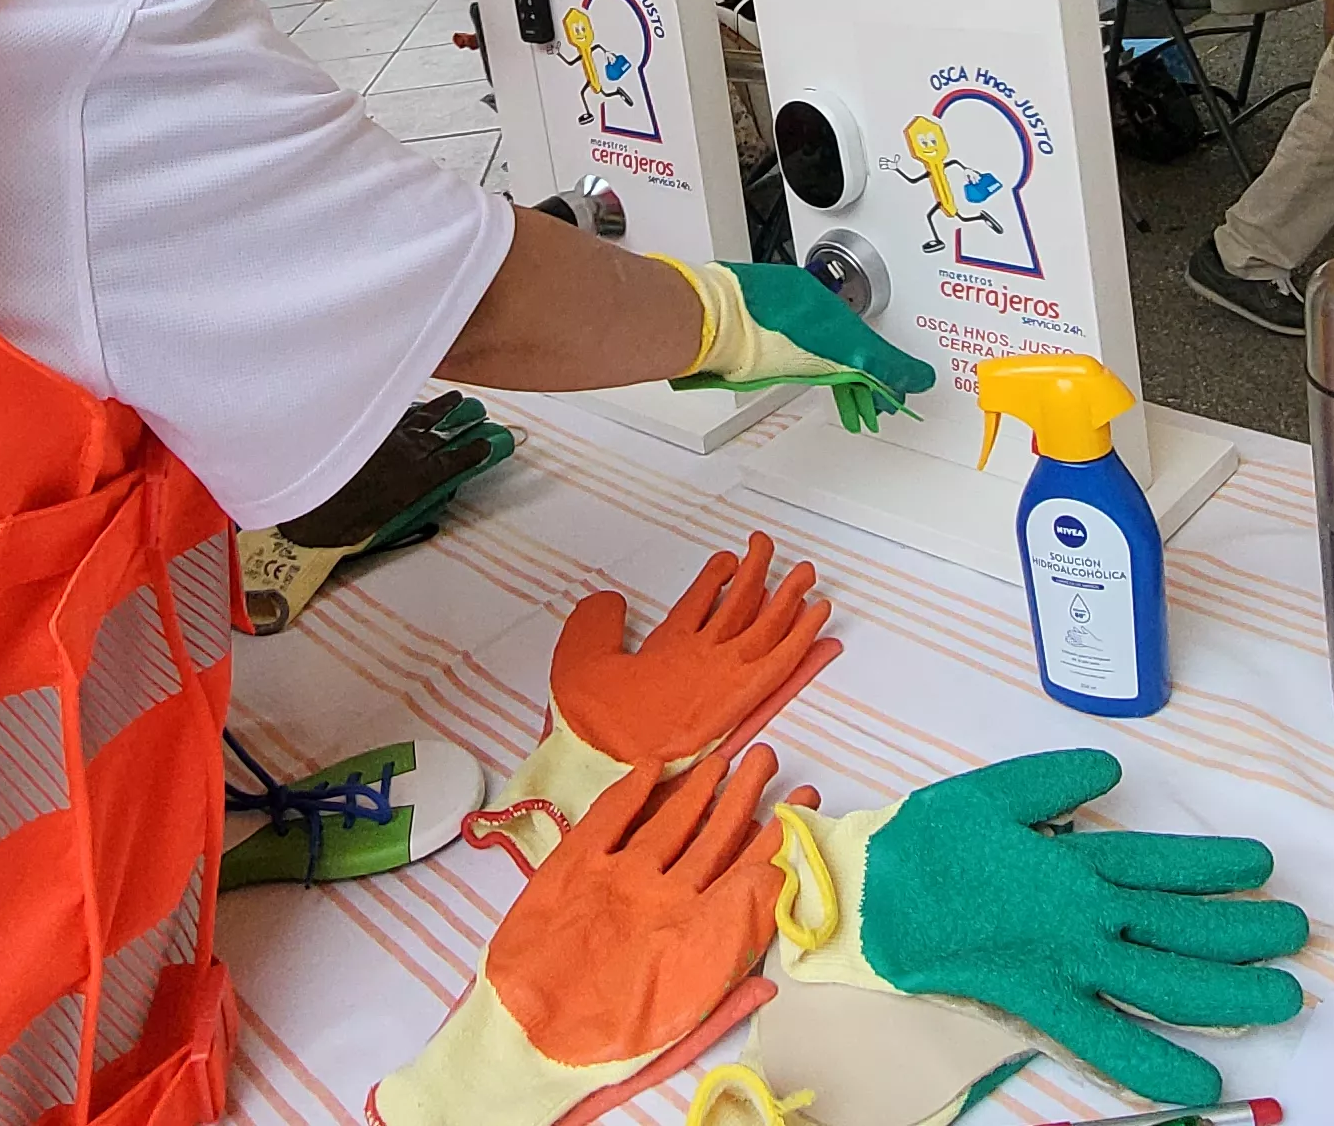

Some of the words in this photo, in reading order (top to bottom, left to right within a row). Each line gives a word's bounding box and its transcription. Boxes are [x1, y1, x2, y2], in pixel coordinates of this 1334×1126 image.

[930, 65, 969, 91] OSCA
[975, 67, 1015, 99] Hnos
[1014, 99, 1054, 155] JUSTO
[590, 138, 628, 152] maestros
[592, 148, 674, 177] cerrajeros
[648, 175, 675, 188] servicio
[939, 269, 993, 287] maestros
[941, 281, 1060, 319] cerrajeros
[916, 315, 959, 336] OSCA
[964, 326, 1014, 349] HNOS.
[1022, 316, 1061, 332] servicio
[1056, 525, 1085, 538] NIVEA
[1032, 556, 1127, 580] HIDROALCOHÓLICA
[1049, 551, 1101, 569] SOLUCIÓN
